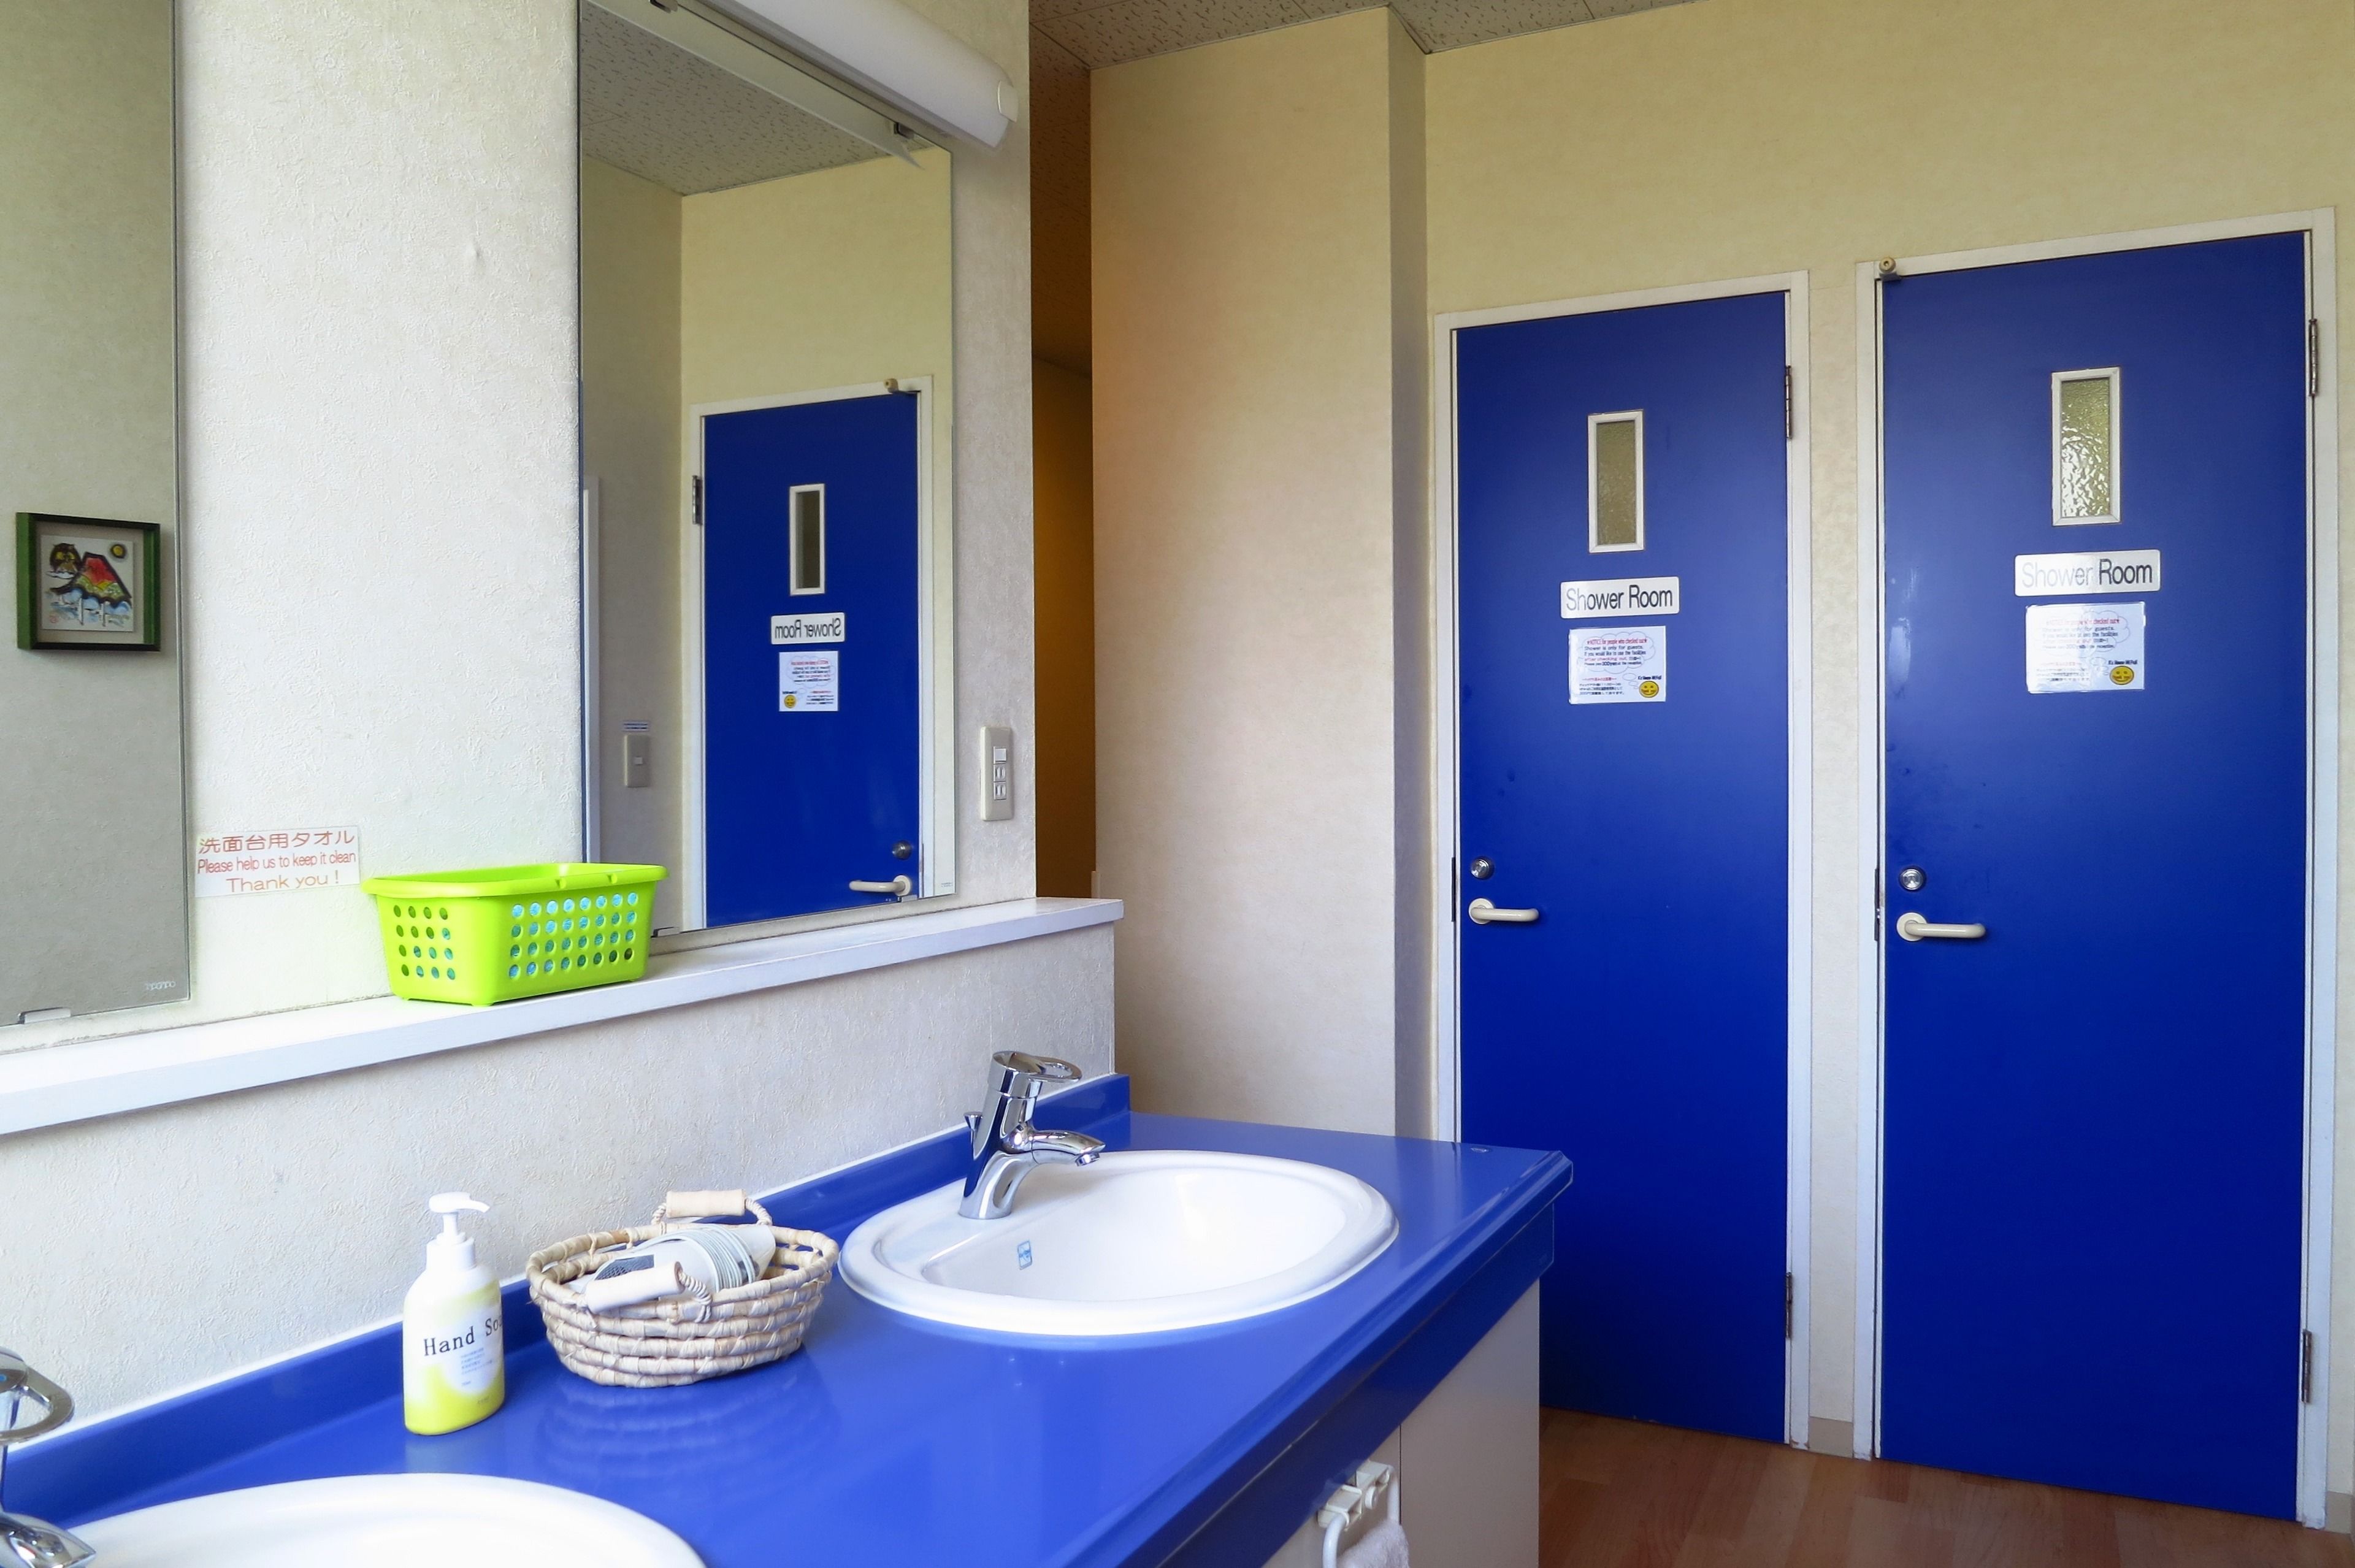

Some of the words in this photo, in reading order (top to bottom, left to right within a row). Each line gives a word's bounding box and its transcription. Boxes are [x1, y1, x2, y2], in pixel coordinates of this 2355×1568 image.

[2022, 562, 2093, 588] Shower
[2099, 559, 2153, 585] Room
[1566, 587, 1625, 611] Shower
[1628, 584, 1673, 609] Room
[198, 830, 355, 854] 洗面台用タオル
[197, 859, 233, 874] Please
[236, 856, 259, 871] help
[262, 859, 276, 869] us
[280, 856, 289, 868] to
[293, 853, 318, 868] keep
[320, 852, 327, 865] it
[329, 850, 356, 864] clean
[226, 874, 289, 893] Thank
[295, 874, 328, 889] you
[423, 1325, 475, 1356] Hand
